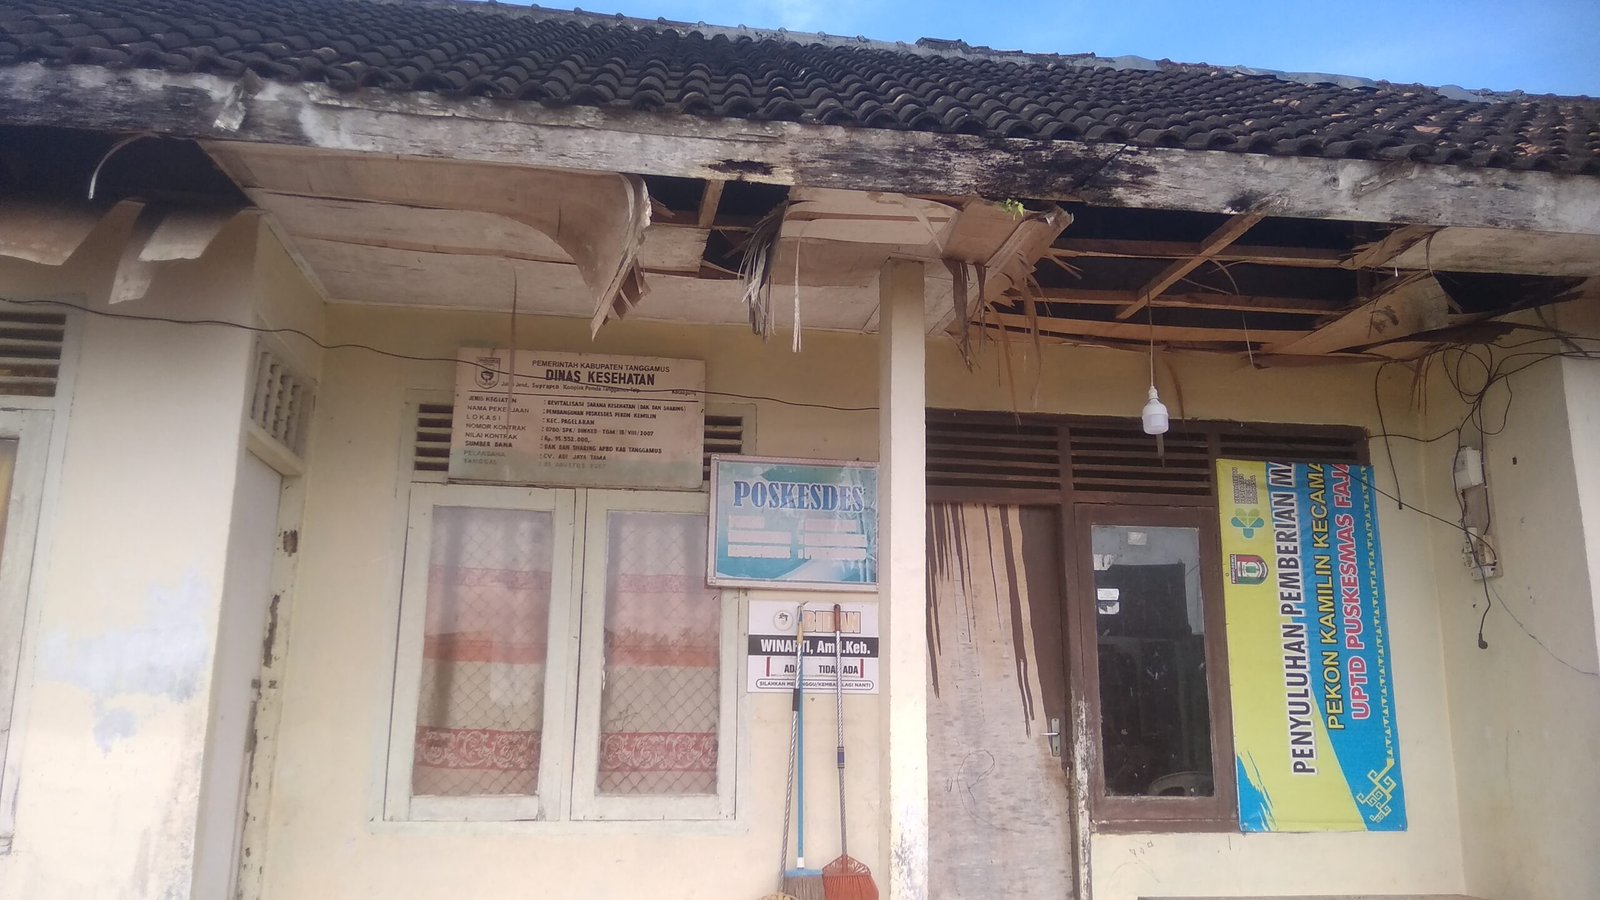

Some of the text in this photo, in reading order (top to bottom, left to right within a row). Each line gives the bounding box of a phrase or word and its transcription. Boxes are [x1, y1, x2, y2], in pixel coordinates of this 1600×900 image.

[532, 360, 670, 373] PEMERINTAH KABUPATEN TANGGAMUS
[545, 369, 655, 386] DINAS KESEHATAN
[465, 422, 491, 430] NOMOR
[465, 431, 518, 440] NILAI KONTRAK
[733, 480, 864, 511] POSKESDES
[1272, 492, 1303, 615] PEMBERIAN
[1314, 554, 1338, 645] KAMILIN
[1335, 513, 1366, 650] PUSKESMAS
[818, 665, 838, 674] TIDA
[843, 666, 858, 675] ADA
[1322, 651, 1345, 730] PEKON
[1348, 656, 1371, 720] UPTD
[1281, 624, 1315, 773] PENYULUHAN
